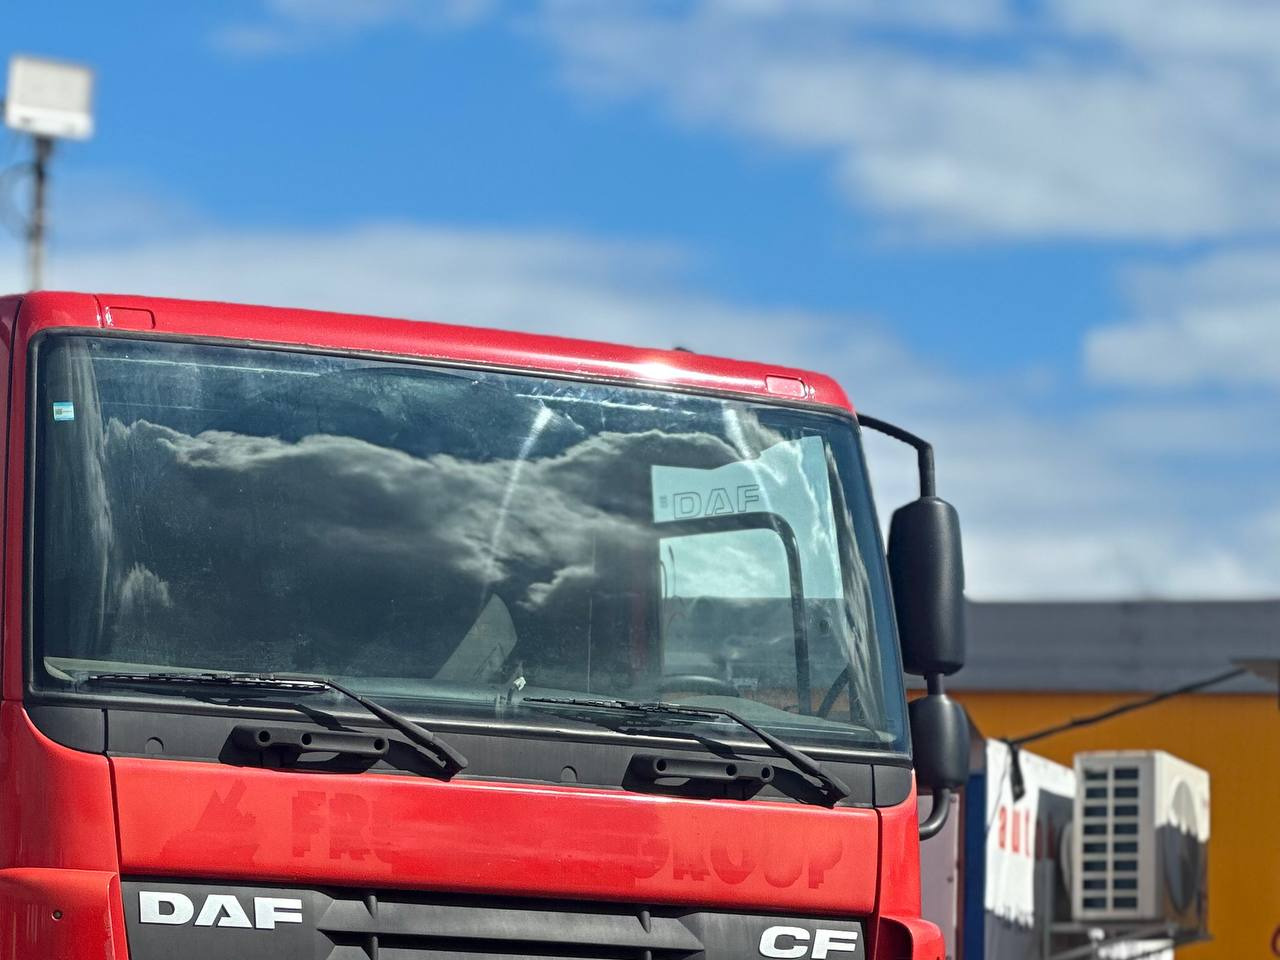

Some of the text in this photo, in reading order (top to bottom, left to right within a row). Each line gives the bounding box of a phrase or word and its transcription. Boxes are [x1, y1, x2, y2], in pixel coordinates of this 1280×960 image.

[673, 484, 760, 519] DAF
[139, 891, 303, 930] DAF
[759, 925, 858, 959] CF
